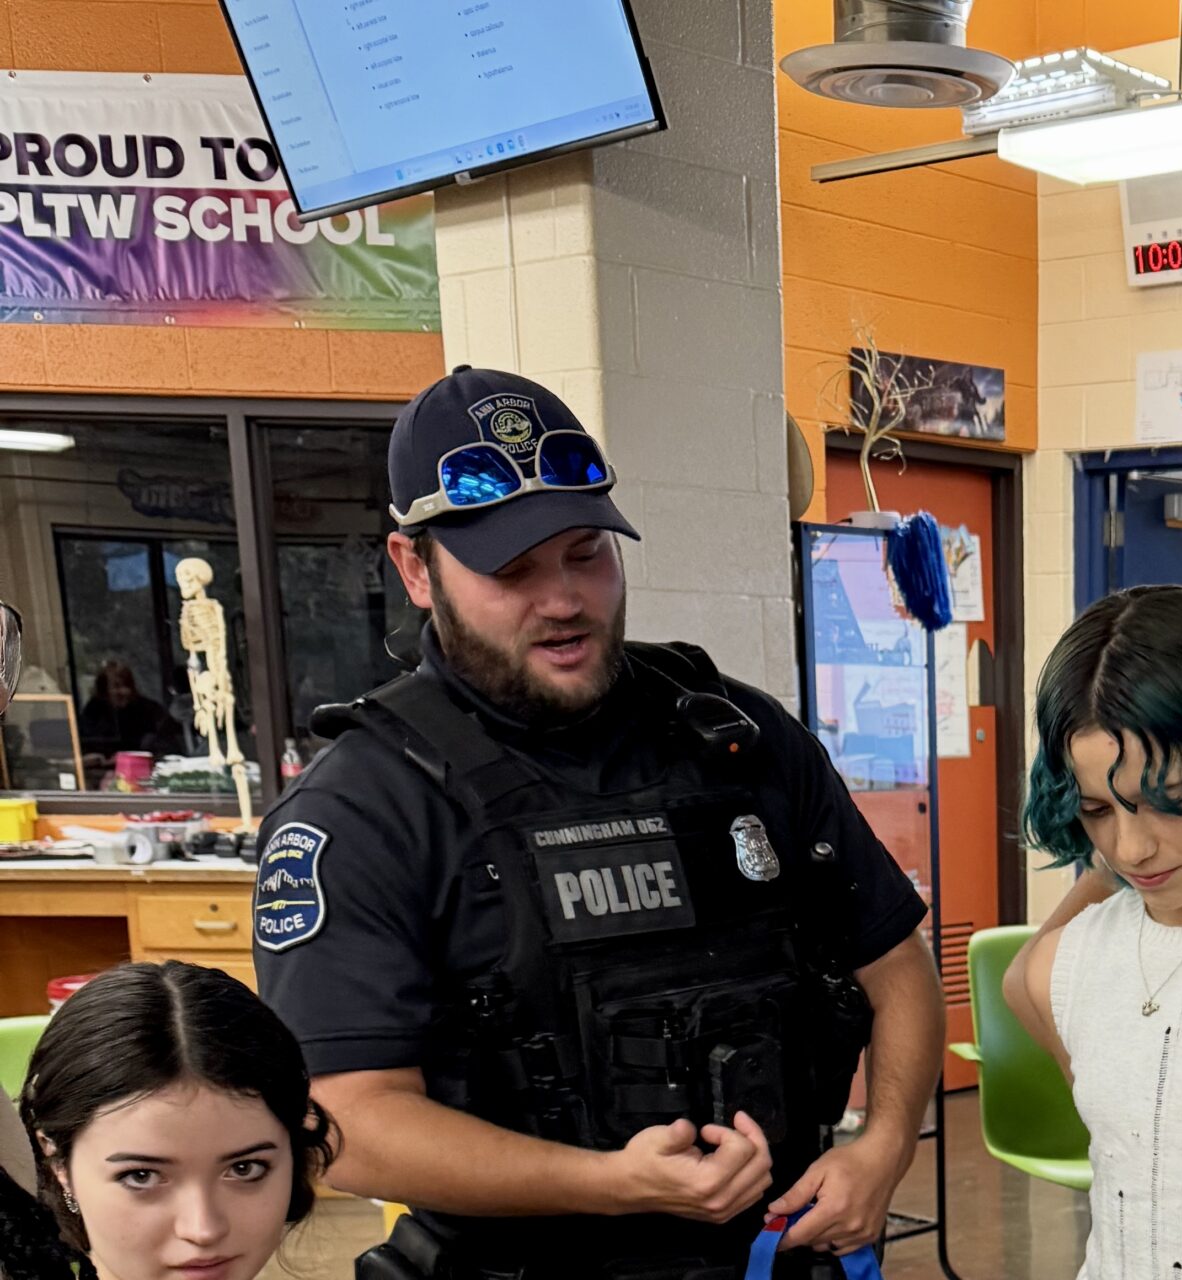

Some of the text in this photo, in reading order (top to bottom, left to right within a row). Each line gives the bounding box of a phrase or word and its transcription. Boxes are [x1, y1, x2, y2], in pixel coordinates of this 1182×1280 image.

[0, 132, 279, 182] ROUD TO
[153, 195, 396, 247] SCHOOL
[495, 398, 531, 409] ARBOR
[499, 438, 539, 454] POLICE
[280, 832, 317, 853] ARBOR
[534, 819, 636, 847] CUNNINGHAM
[554, 860, 682, 920] POLICE
[259, 912, 306, 934] POLICE
